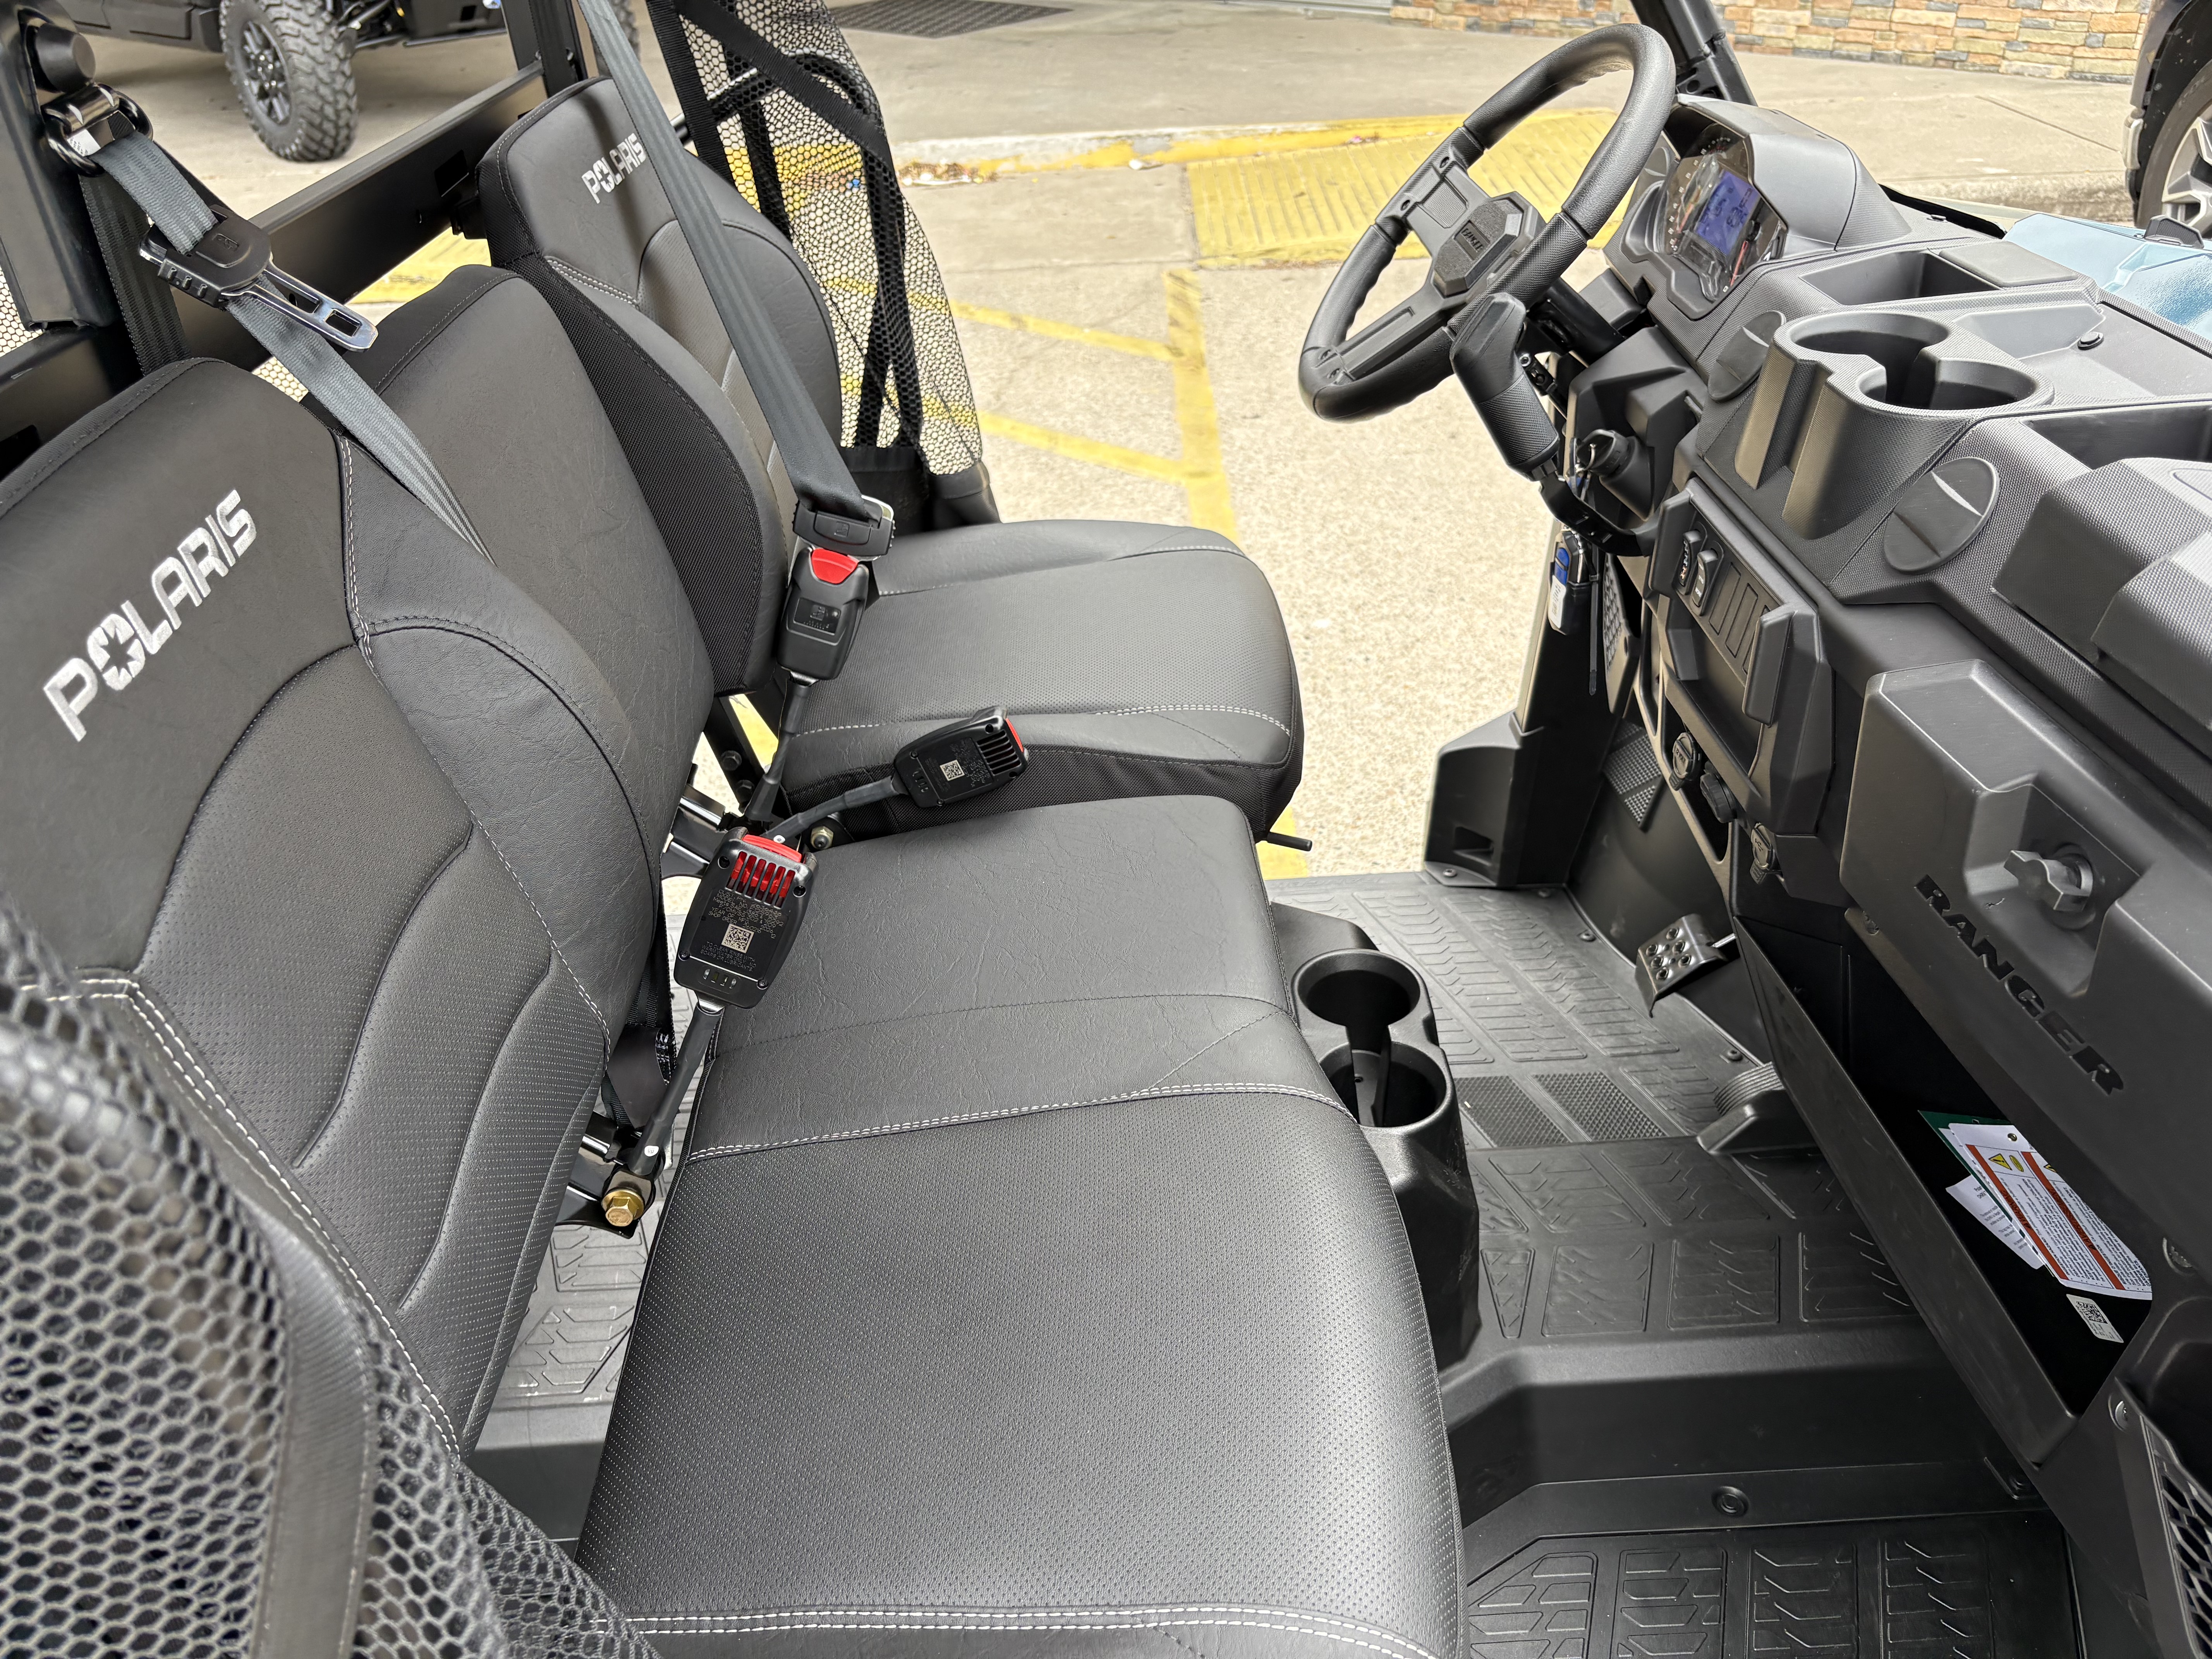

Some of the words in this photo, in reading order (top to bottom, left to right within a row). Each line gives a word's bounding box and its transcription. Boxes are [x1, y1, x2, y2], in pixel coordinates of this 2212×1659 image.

[582, 133, 646, 204] POLARIS
[43, 489, 257, 742] POLARIS
[716, 893, 735, 903] MODEL
[718, 888, 736, 899] CUST.
[708, 910, 721, 919] SHOP
[721, 915, 737, 925] ORDER
[711, 907, 725, 915] YEAR
[759, 925, 774, 934] 2026
[718, 903, 746, 917] F/CMVSS
[746, 914, 759, 922] 302
[763, 921, 776, 929] 209
[1914, 874, 2124, 1096] RANGER
